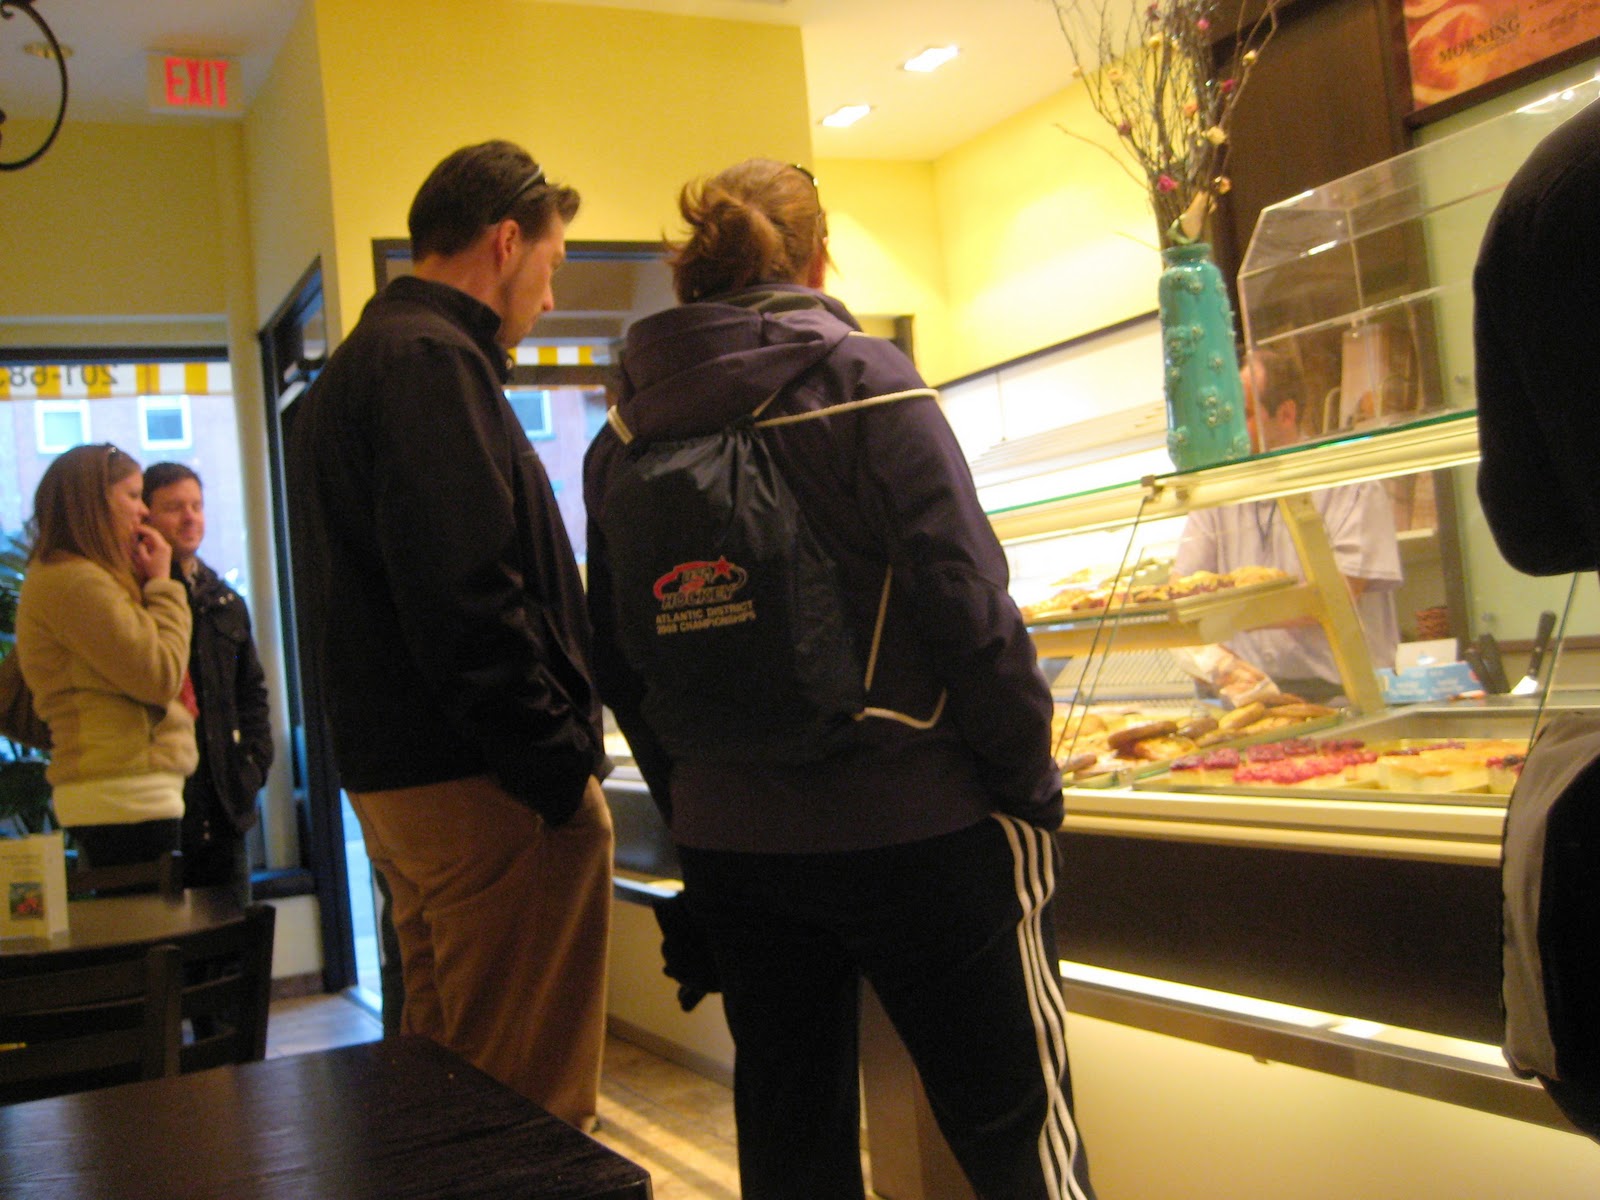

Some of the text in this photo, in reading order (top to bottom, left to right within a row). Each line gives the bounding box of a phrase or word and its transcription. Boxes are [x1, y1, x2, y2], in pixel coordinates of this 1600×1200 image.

[1439, 18, 1520, 63] MORNING
[164, 56, 228, 107] EXIT
[656, 608, 704, 624] ATLANTIC
